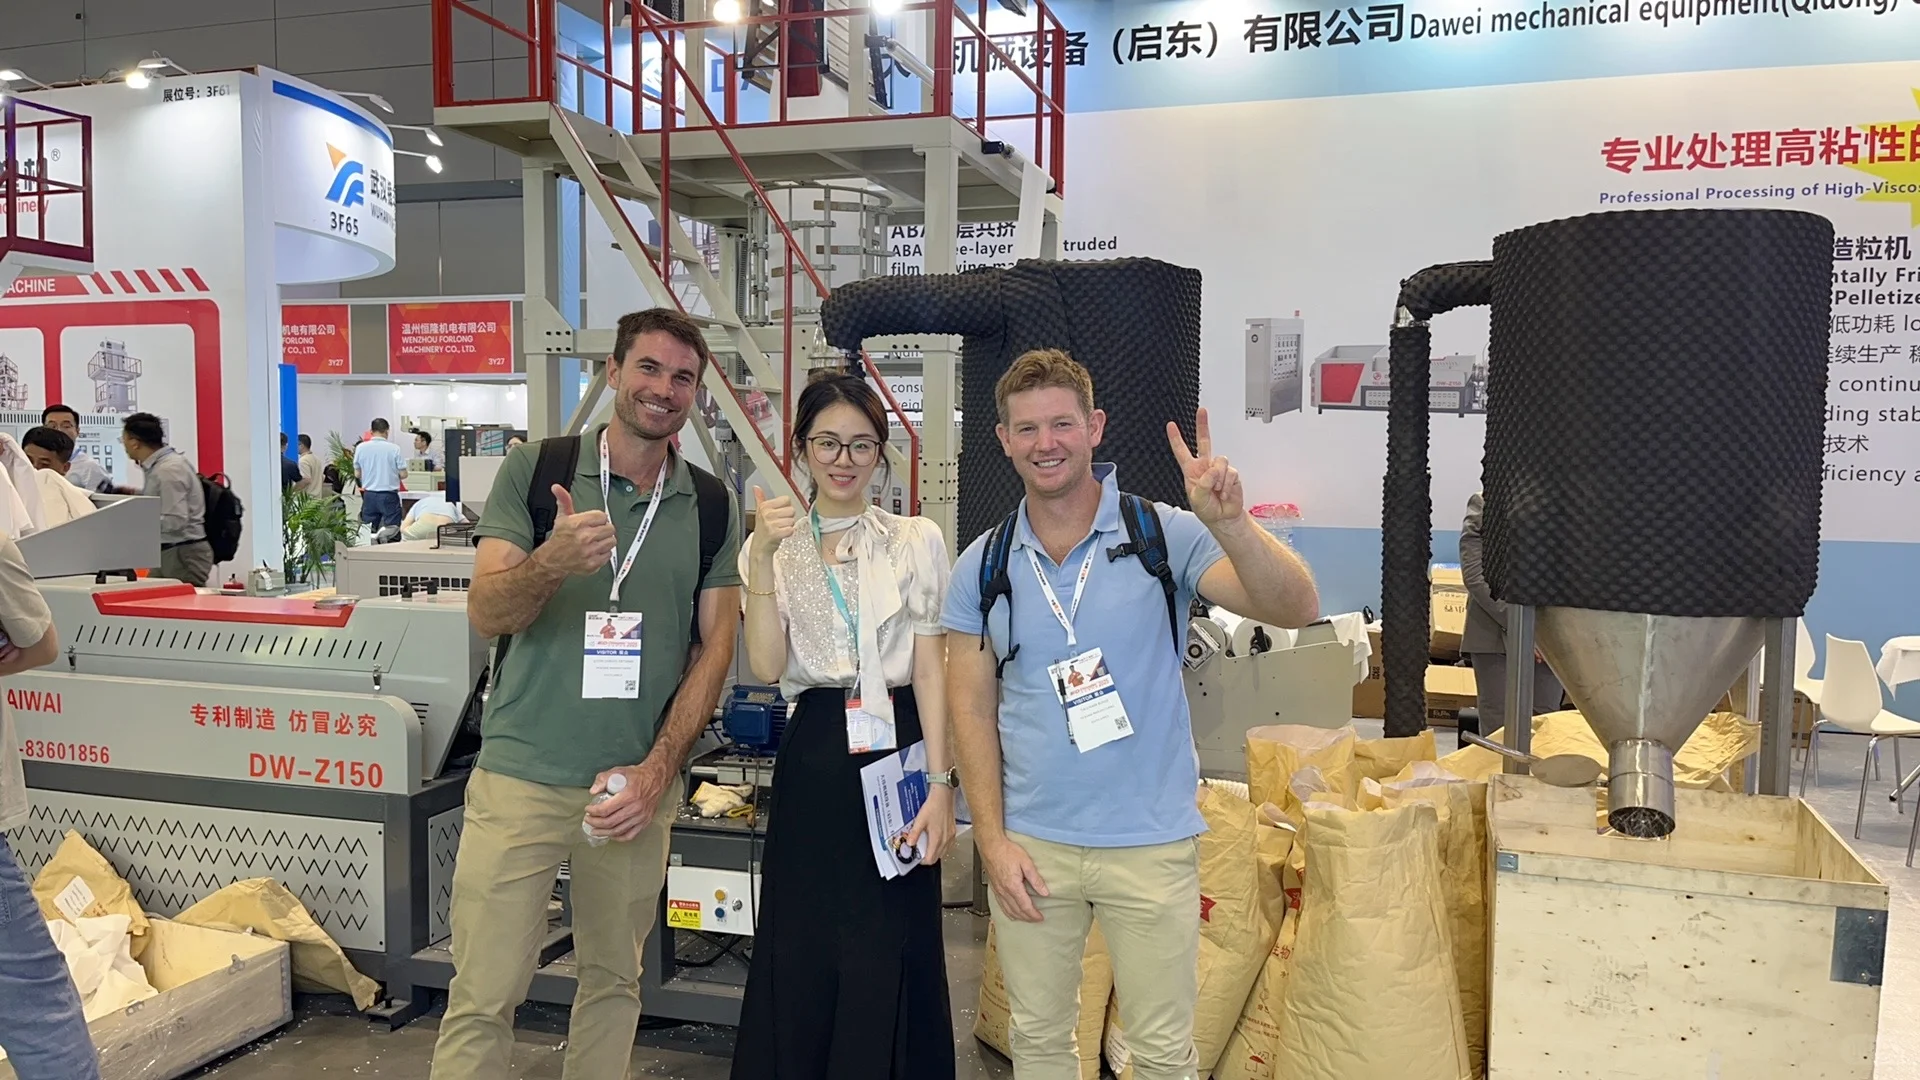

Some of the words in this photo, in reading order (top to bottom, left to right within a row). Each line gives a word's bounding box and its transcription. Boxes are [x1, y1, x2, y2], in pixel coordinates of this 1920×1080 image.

[1410, 8, 1481, 39] Dawei
[1491, 0, 1629, 33] mechanical
[206, 84, 230, 98] 3F61
[1600, 187, 1699, 204] Professional
[1706, 182, 1795, 200] Processing
[1801, 183, 1820, 196] of
[330, 211, 359, 236] 3F65
[892, 244, 922, 257] ABA
[956, 241, 1013, 258] e-layer
[1062, 236, 1117, 252] truded
[402, 321, 496, 335] 温州恒隆机电有限公司
[1830, 314, 1895, 334] 低功耗
[402, 335, 437, 345] WENZHOU
[439, 335, 474, 344] FORLONG
[402, 346, 443, 354] MACHINERY
[328, 358, 344, 366] 3Y27
[488, 357, 505, 366] 3Y27
[1825, 434, 1869, 454] 技术
[190, 703, 276, 732] 专利制造
[288, 709, 377, 738] 仿冒必究
[249, 752, 383, 789] DW-Z150
